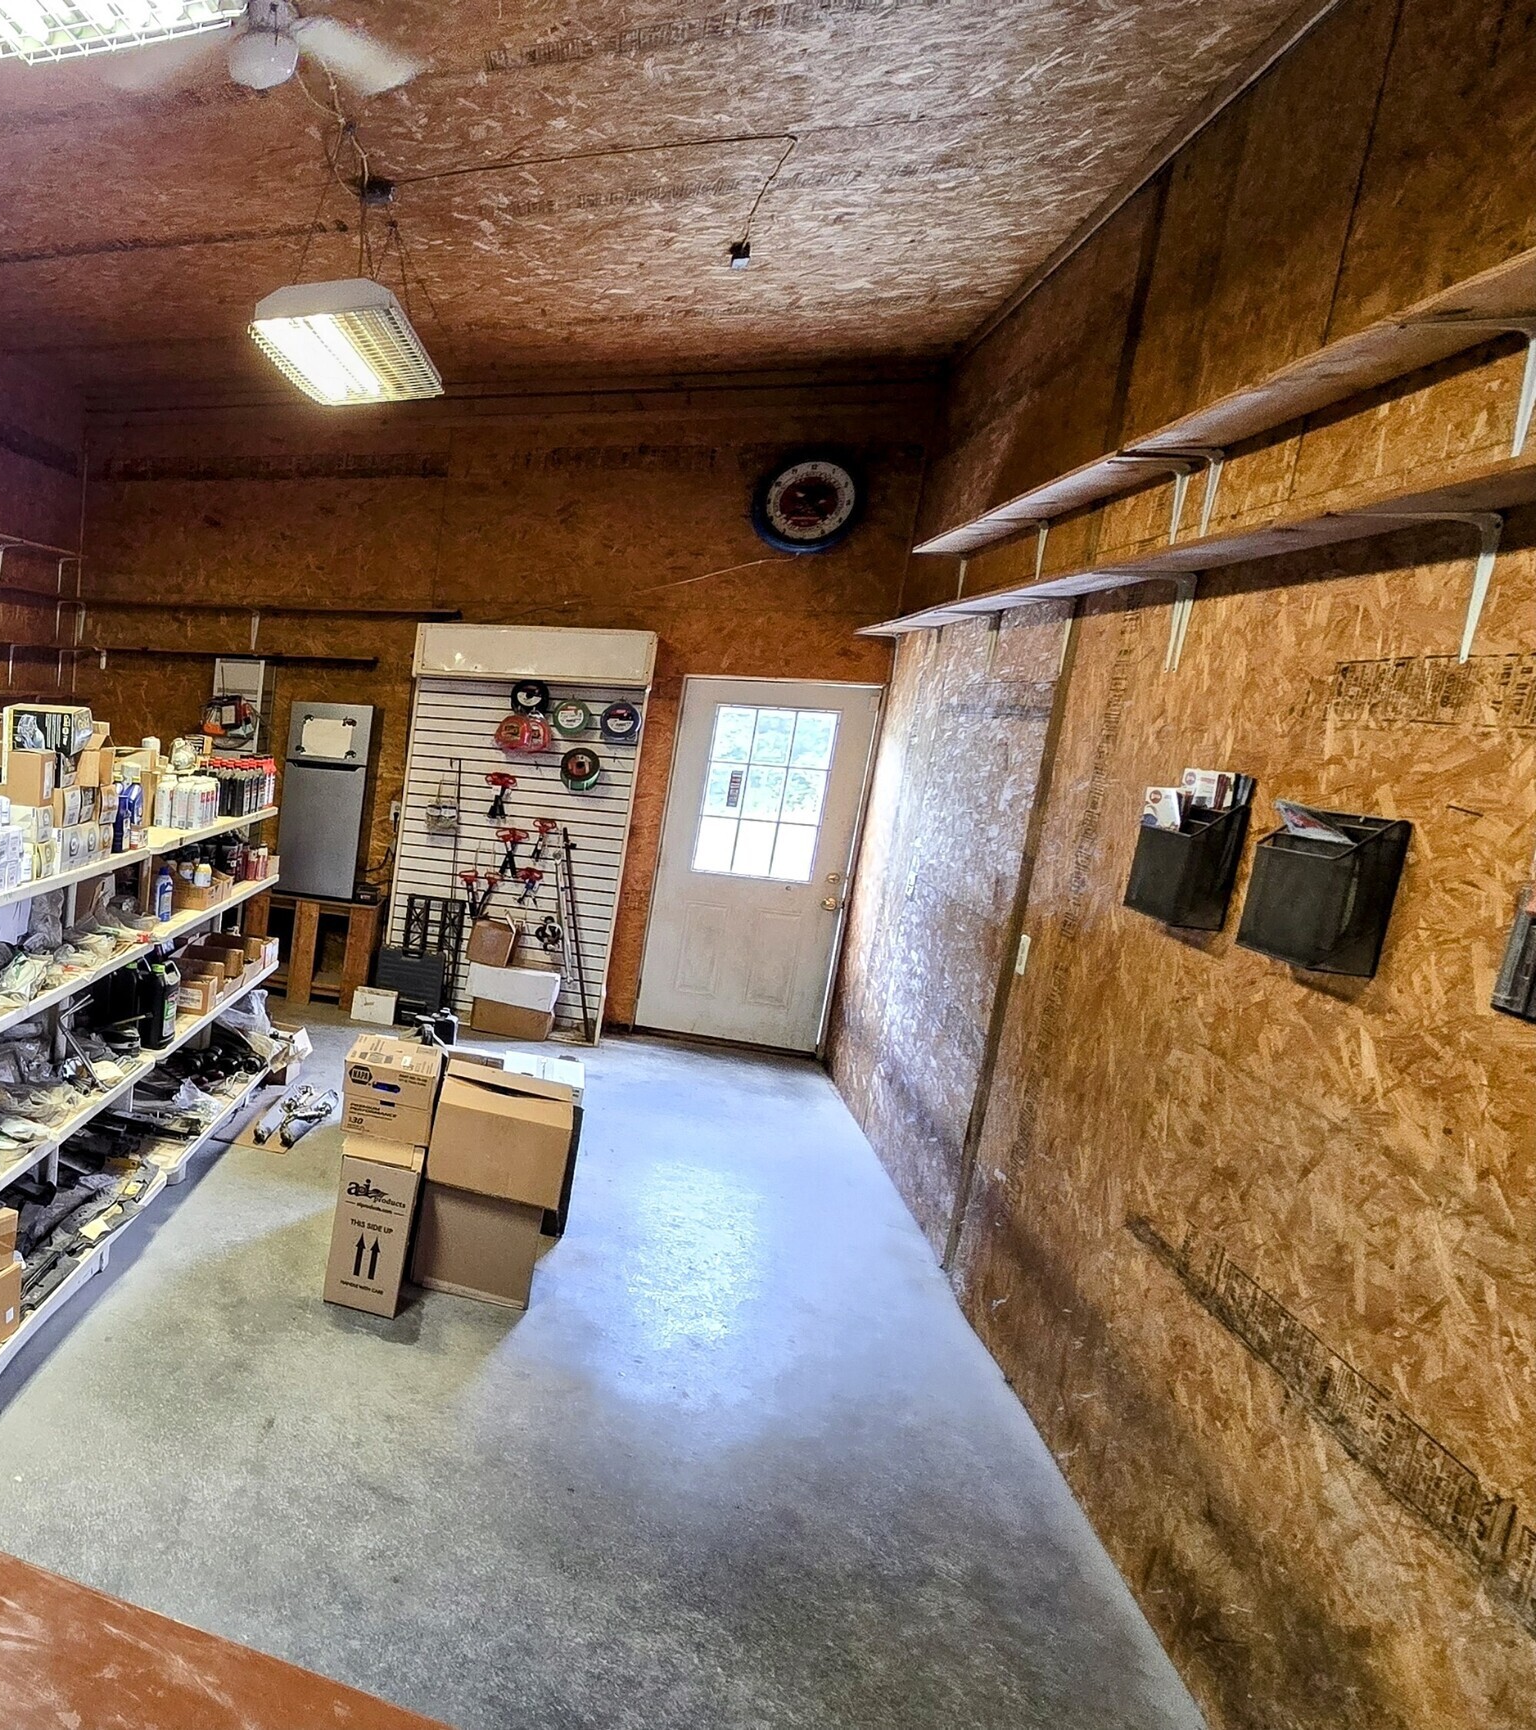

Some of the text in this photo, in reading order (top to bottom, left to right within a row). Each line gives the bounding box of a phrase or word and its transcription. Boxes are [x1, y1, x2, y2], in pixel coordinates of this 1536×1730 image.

[352, 1069, 369, 1080] NAPA
[350, 1103, 381, 1111] PREMIUM
[350, 1106, 397, 1118] PERFORMANCE
[373, 1195, 406, 1209] products
[350, 1218, 394, 1235] THIS SIDE UP
[340, 1280, 384, 1295] HANDLE WITH CARE
